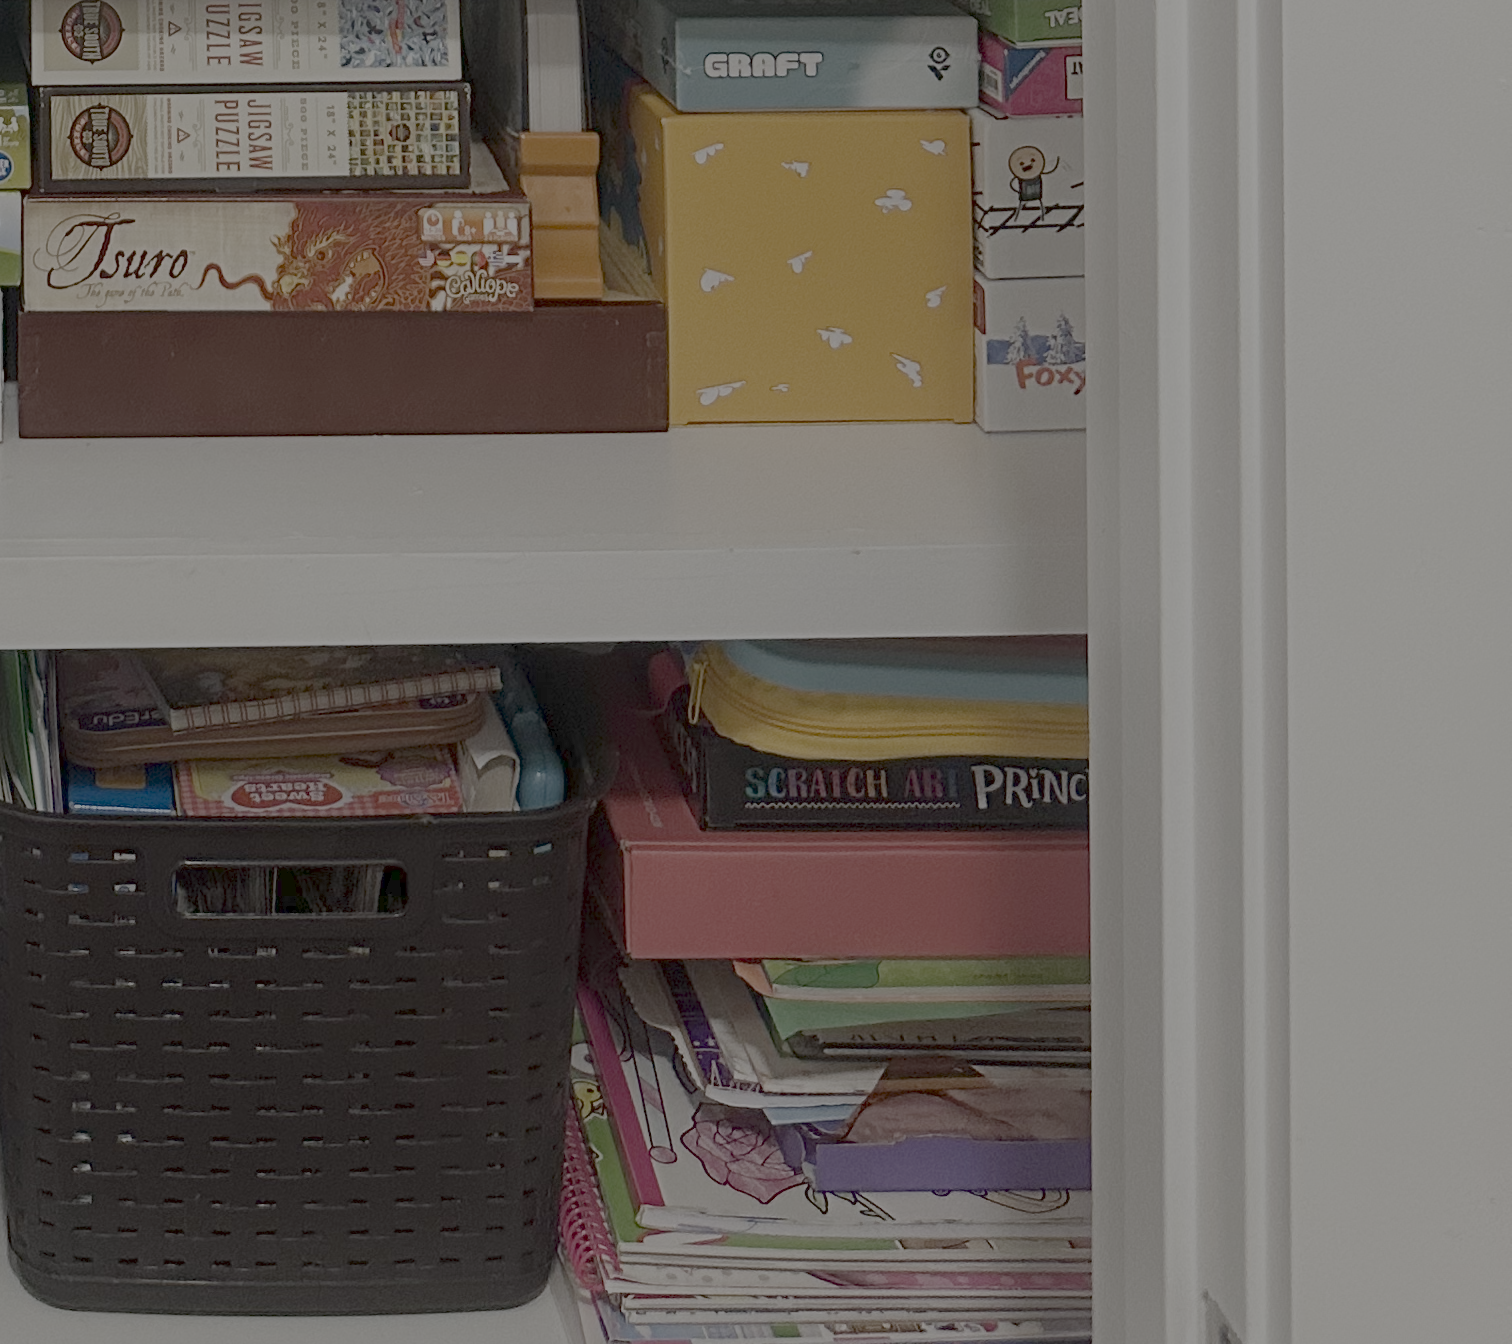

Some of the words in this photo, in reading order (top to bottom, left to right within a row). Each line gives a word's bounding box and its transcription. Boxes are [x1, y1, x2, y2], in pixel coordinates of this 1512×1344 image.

[703, 51, 824, 78] GRAFT
[214, 99, 241, 172] PUZZLE
[246, 99, 273, 171] JIGSAW
[445, 268, 520, 301] Calliope
[744, 767, 887, 800] SCRATCH
[903, 767, 961, 800] ART
